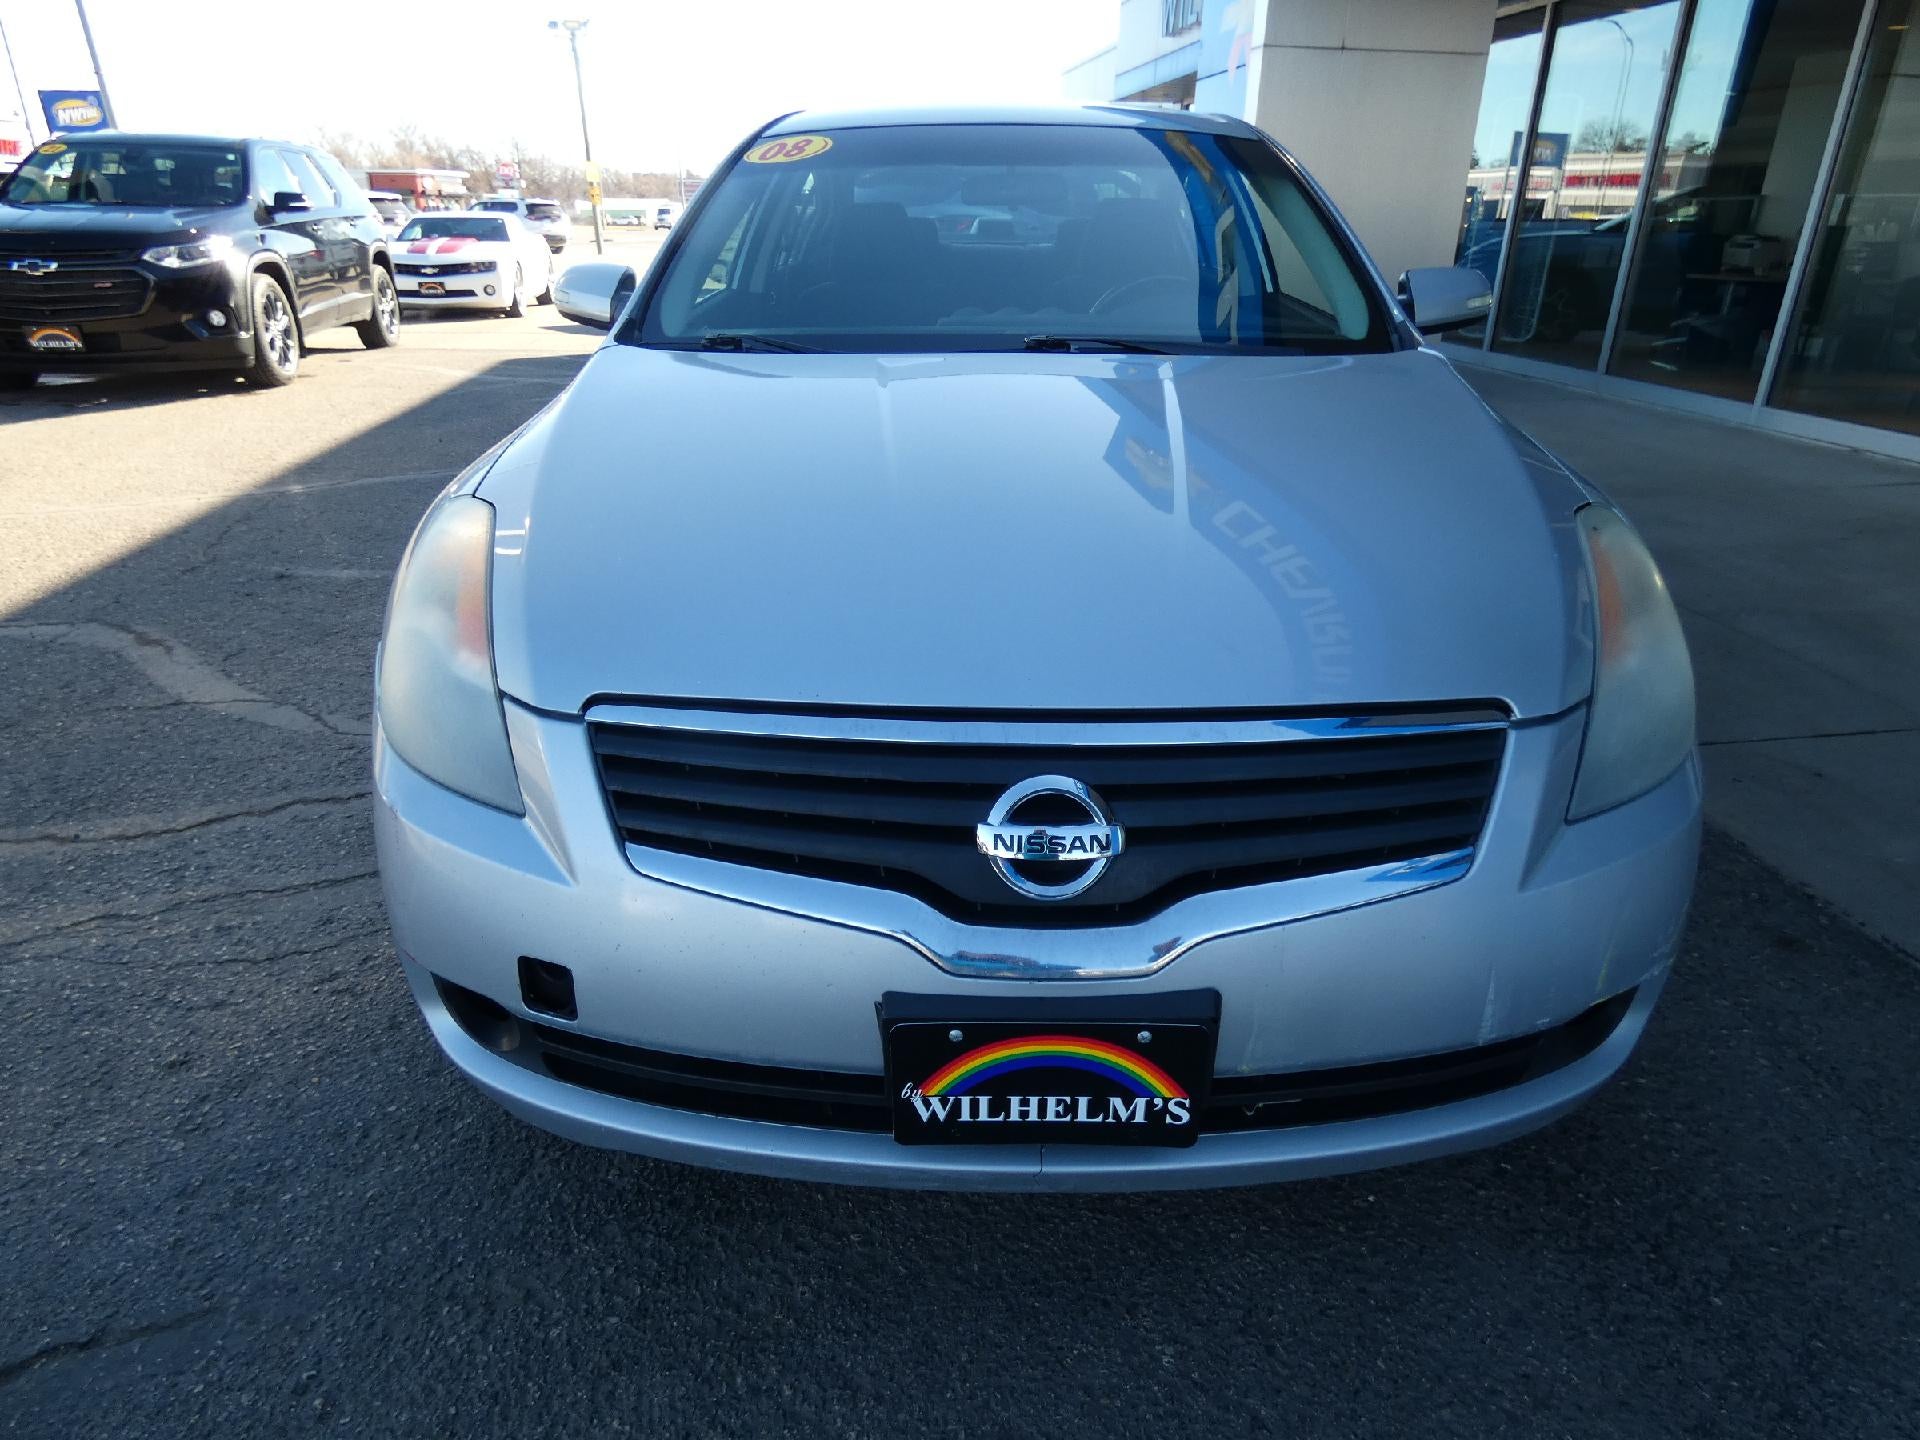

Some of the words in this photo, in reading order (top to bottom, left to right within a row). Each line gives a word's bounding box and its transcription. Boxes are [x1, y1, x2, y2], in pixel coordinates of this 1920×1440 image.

[758, 138, 814, 161] 08
[993, 833, 1111, 855] NISSAN
[901, 1082, 925, 1102] by
[912, 1095, 1191, 1125] WILHELM'S
